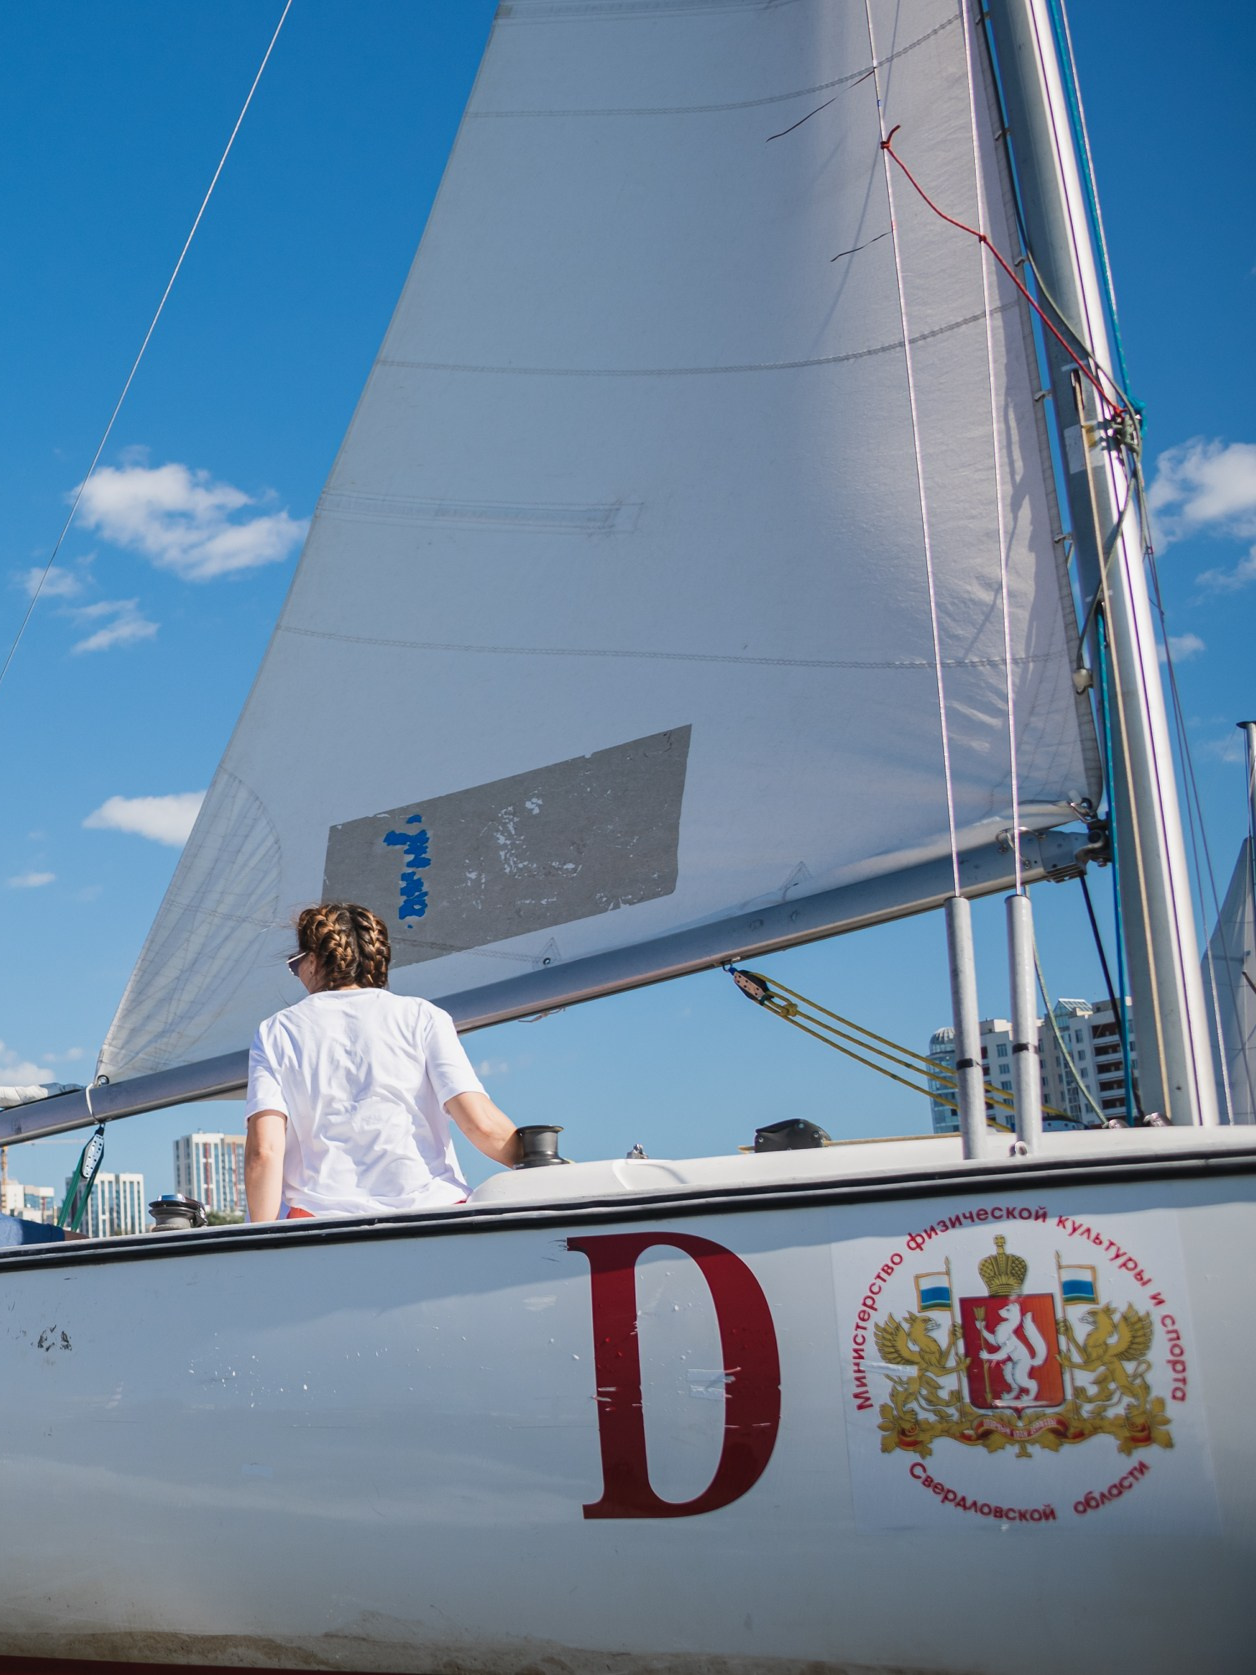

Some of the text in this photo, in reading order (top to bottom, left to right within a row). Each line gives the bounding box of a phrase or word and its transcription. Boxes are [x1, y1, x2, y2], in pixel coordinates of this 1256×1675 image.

[566, 1231, 782, 1520] D
[851, 1206, 1187, 1411] Министерство физической культуры и спорта
[909, 1460, 1150, 1522] Свердловской области
